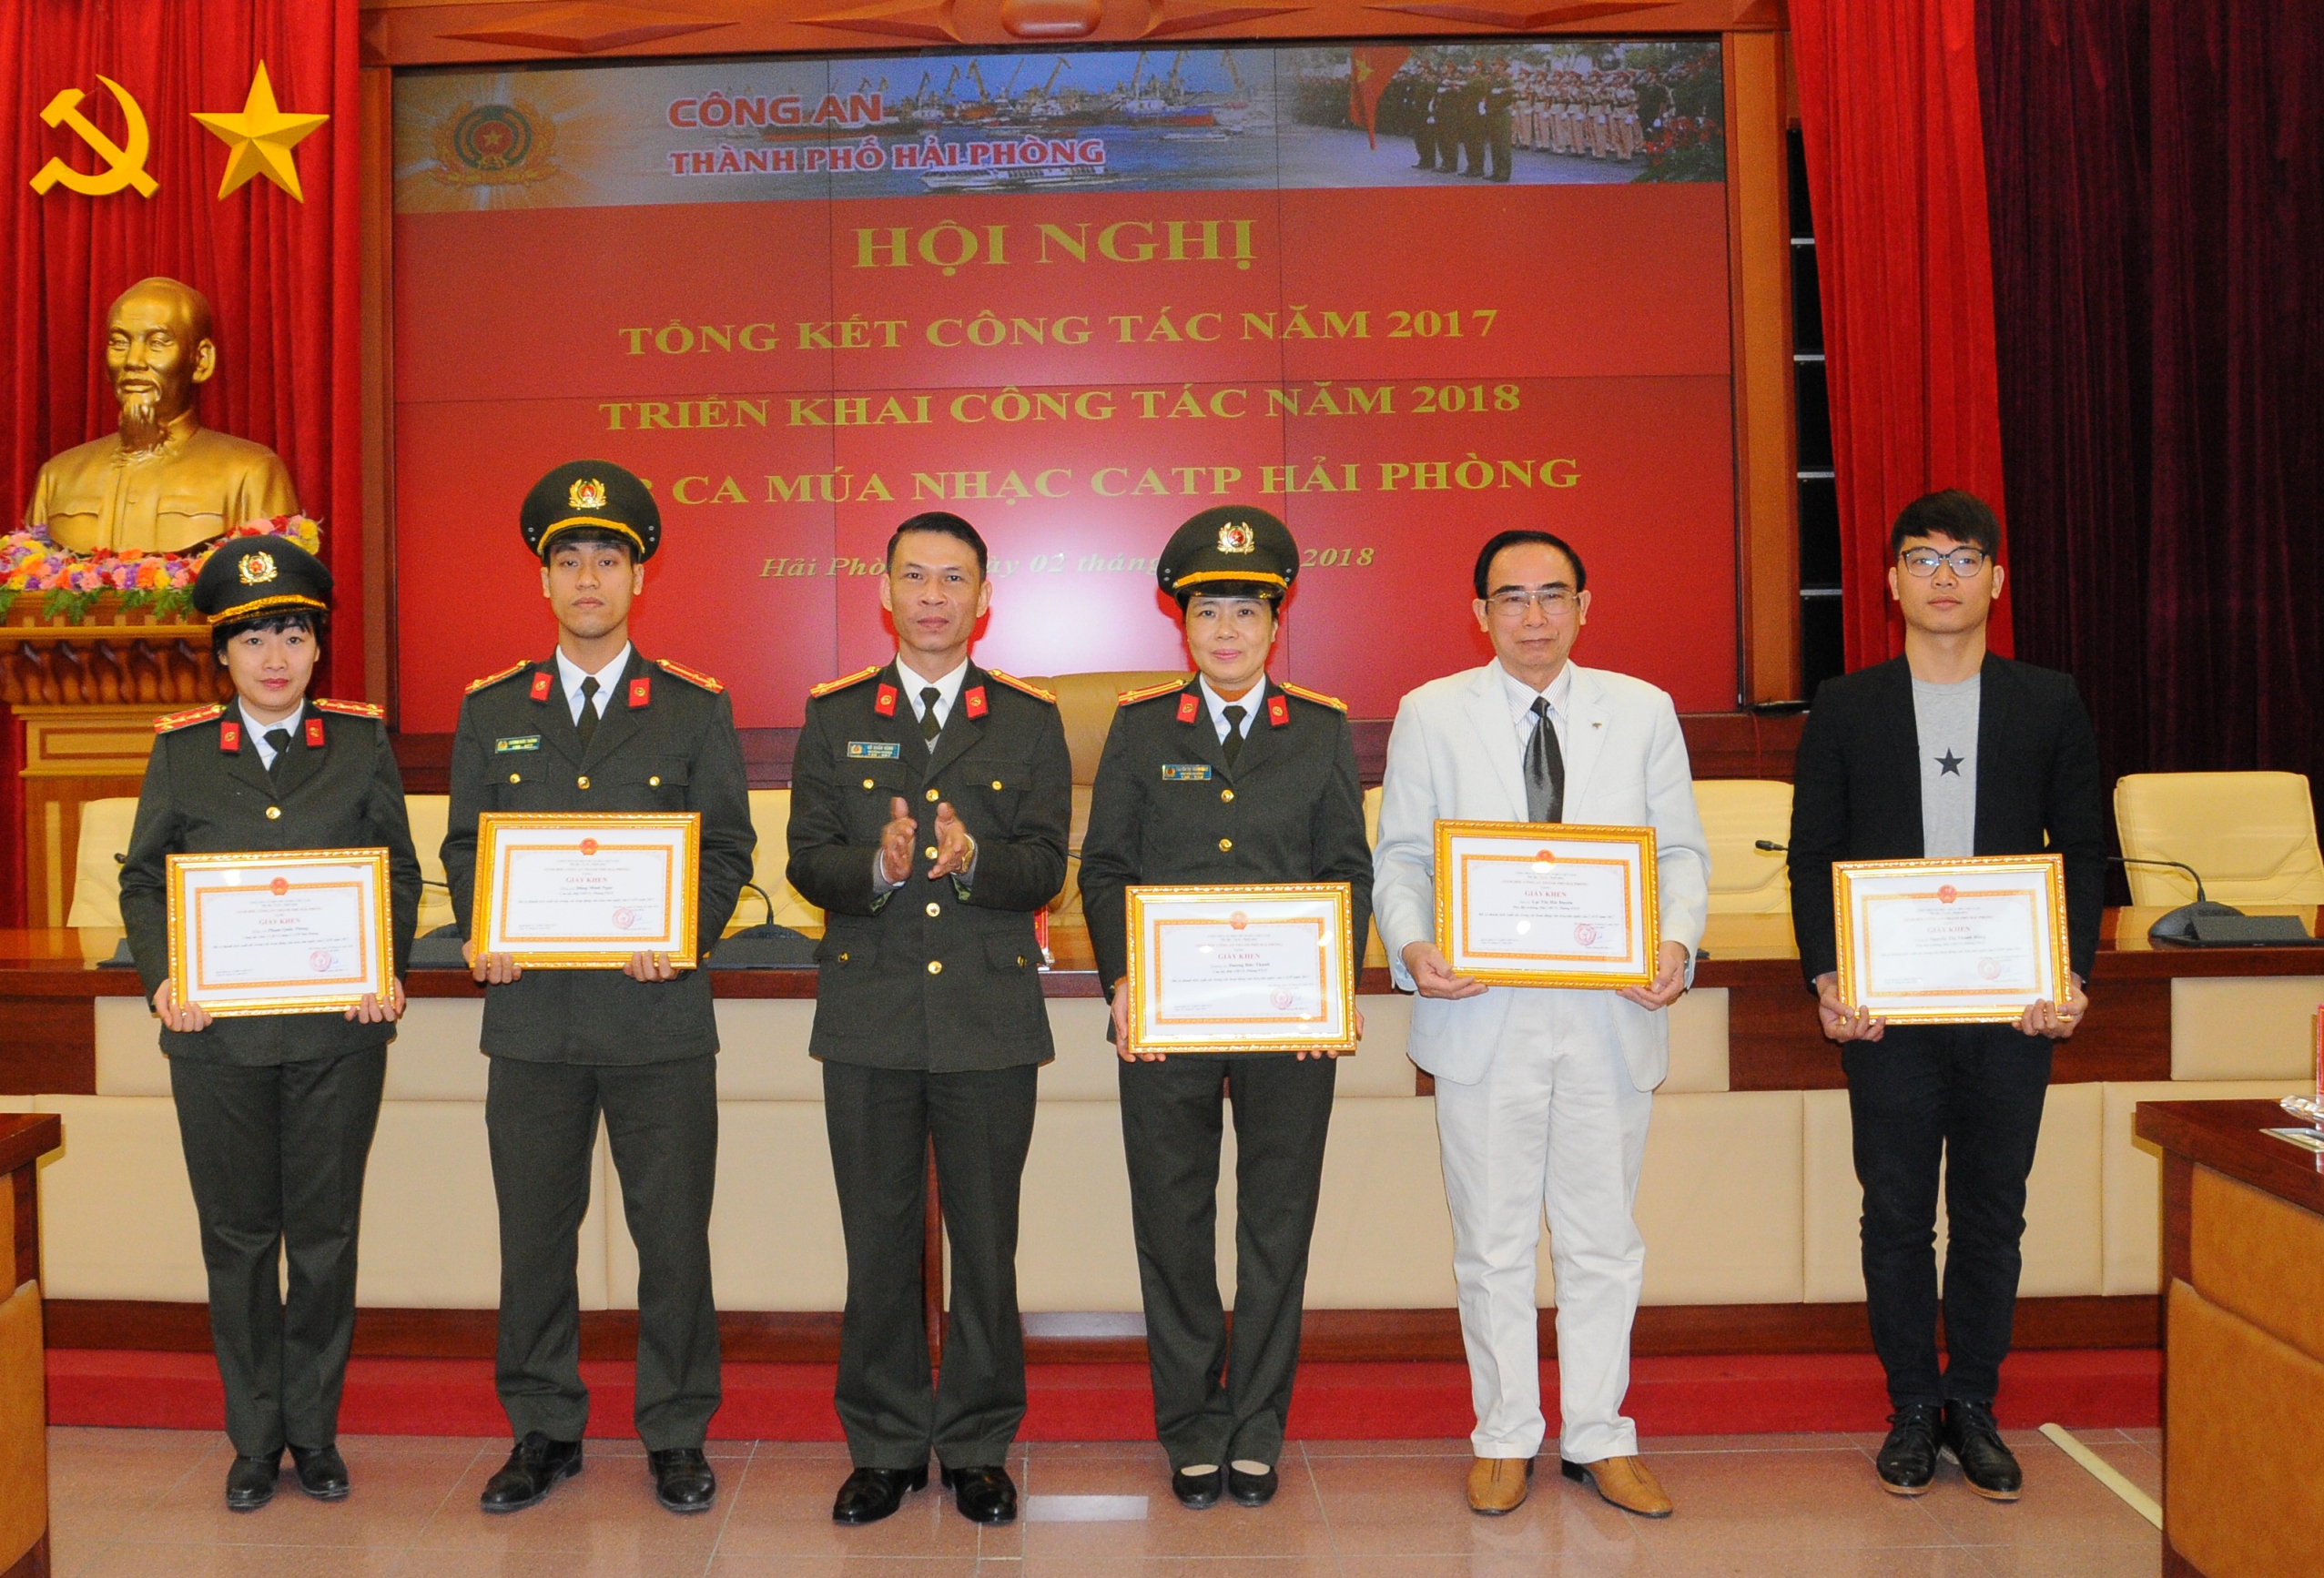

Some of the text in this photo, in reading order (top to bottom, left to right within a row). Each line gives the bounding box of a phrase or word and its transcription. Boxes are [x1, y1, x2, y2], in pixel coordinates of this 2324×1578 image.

[670, 92, 882, 127] CÔNG AN
[670, 136, 1105, 174] THÀNH PHỐ HẢI PHÒNG
[852, 218, 1257, 277] HỘI NGHỊ
[796, 313, 907, 349] KẾT
[926, 309, 1092, 347] CÔNG
[1109, 306, 1222, 342] TÁC
[1240, 305, 1370, 339] NĂM
[1386, 309, 1498, 338] 2017
[787, 395, 933, 427] KHAI
[949, 385, 1116, 421] CÔNG
[1132, 383, 1247, 419] TÁC
[1264, 380, 1395, 416] NĂM
[1411, 384, 1520, 413] 2018
[673, 452, 1582, 506] CA MÚA NHẠC CATP HẢI PHÒNG
[759, 557, 817, 578] Hải
[825, 557, 888, 577] Phò
[1030, 553, 1066, 573] 02
[1300, 548, 1375, 567] 2018
